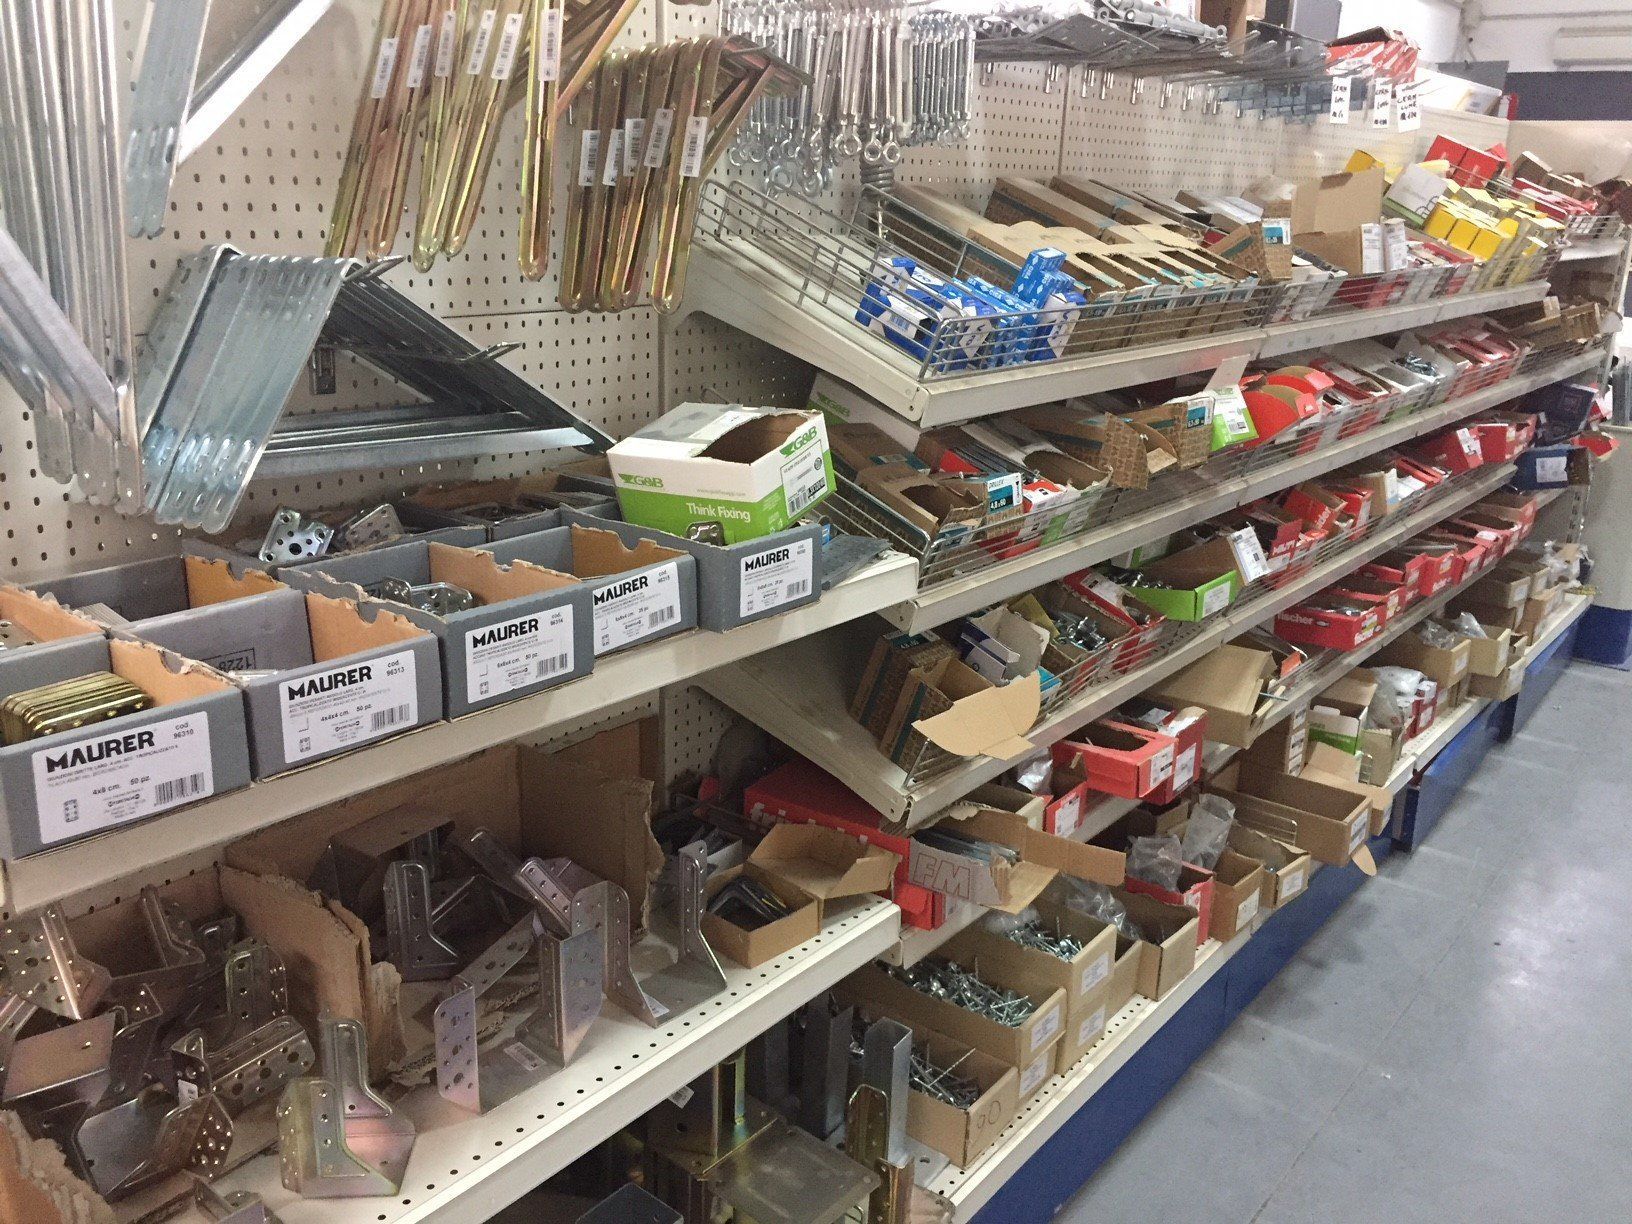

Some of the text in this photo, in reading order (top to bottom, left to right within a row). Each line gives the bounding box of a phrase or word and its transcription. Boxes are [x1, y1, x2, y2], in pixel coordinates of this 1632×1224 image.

[634, 476, 664, 488] G&B
[686, 502, 751, 524] Think Fixing
[744, 548, 790, 572] MAURER
[593, 575, 649, 606] MAURER
[472, 618, 539, 649] MAURER
[287, 665, 373, 701] MAURER
[46, 731, 155, 774] MAURER
[912, 852, 971, 900] FM
